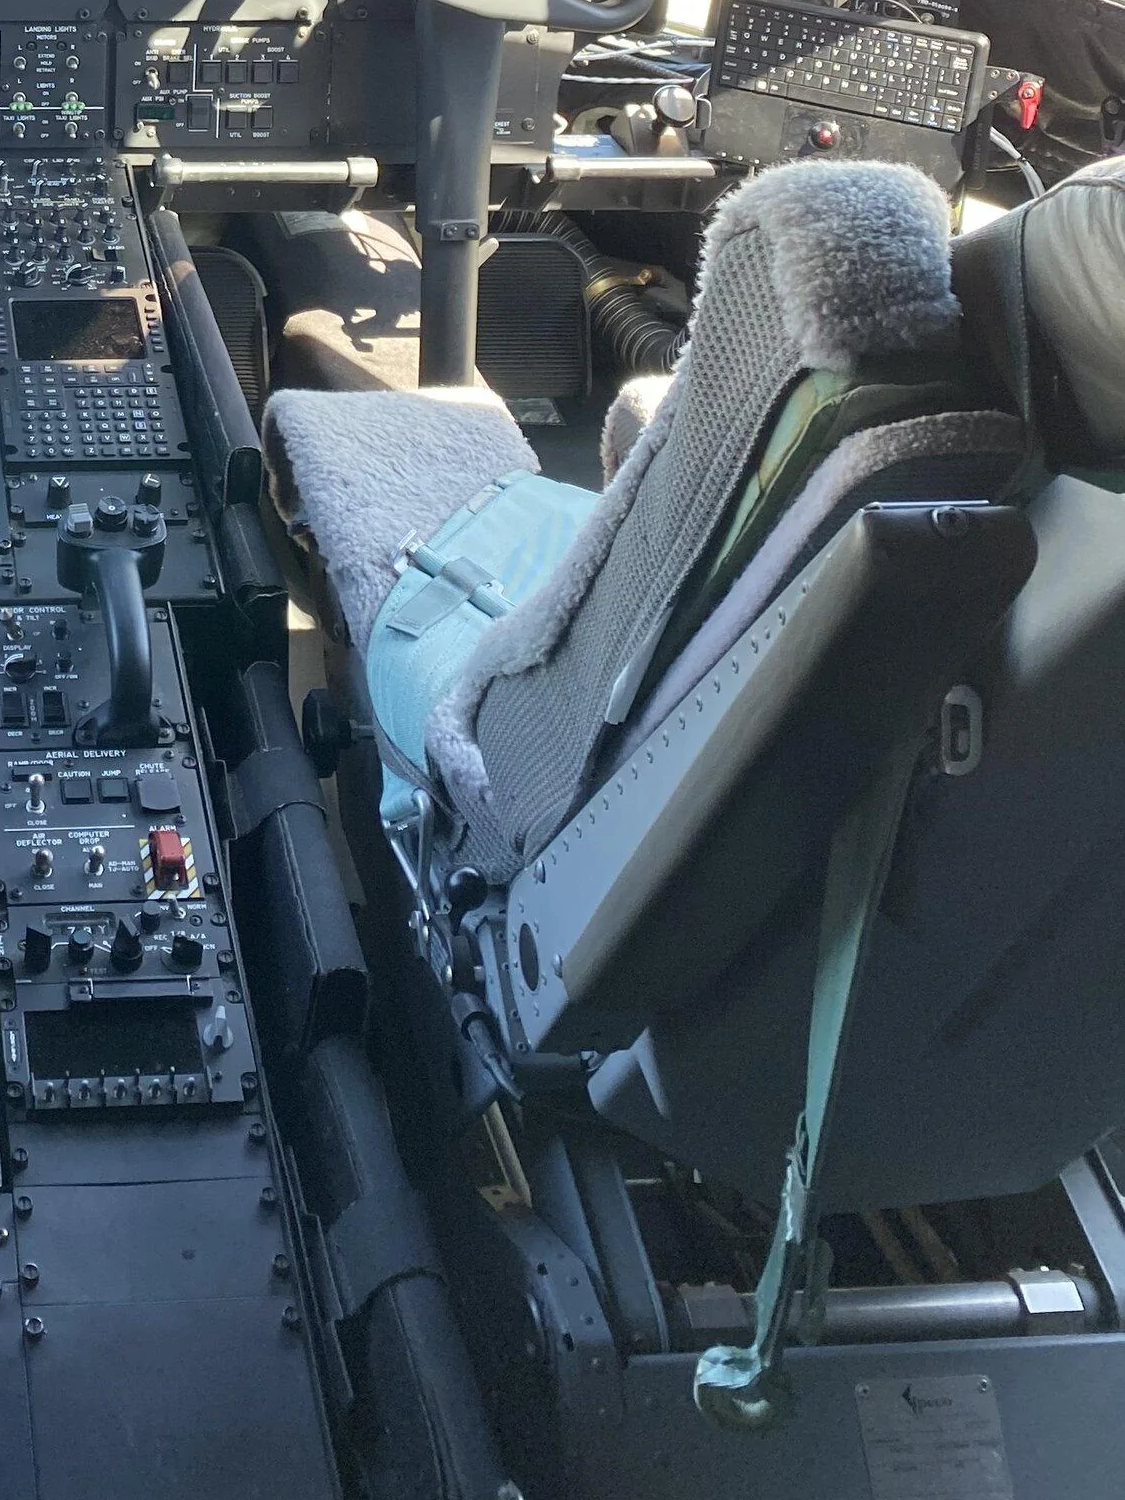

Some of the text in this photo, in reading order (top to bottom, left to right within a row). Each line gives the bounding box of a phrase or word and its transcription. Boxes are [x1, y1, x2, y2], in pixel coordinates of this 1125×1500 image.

[54, 25, 77, 33] LIGHTS
[45, 749, 126, 759] AERIAL DELIVERY
[139, 763, 165, 771] CHUTE
[57, 770, 91, 778] CAUTION
[101, 769, 122, 777] JUMP
[148, 824, 178, 833] ALARM
[32, 832, 46, 840] AIR
[68, 830, 110, 839] COMPUTER
[16, 838, 63, 847] DEFLECTOR
[79, 837, 100, 845] DROP
[33, 883, 56, 891] CLOSE
[60, 905, 95, 913] CHANNEL
